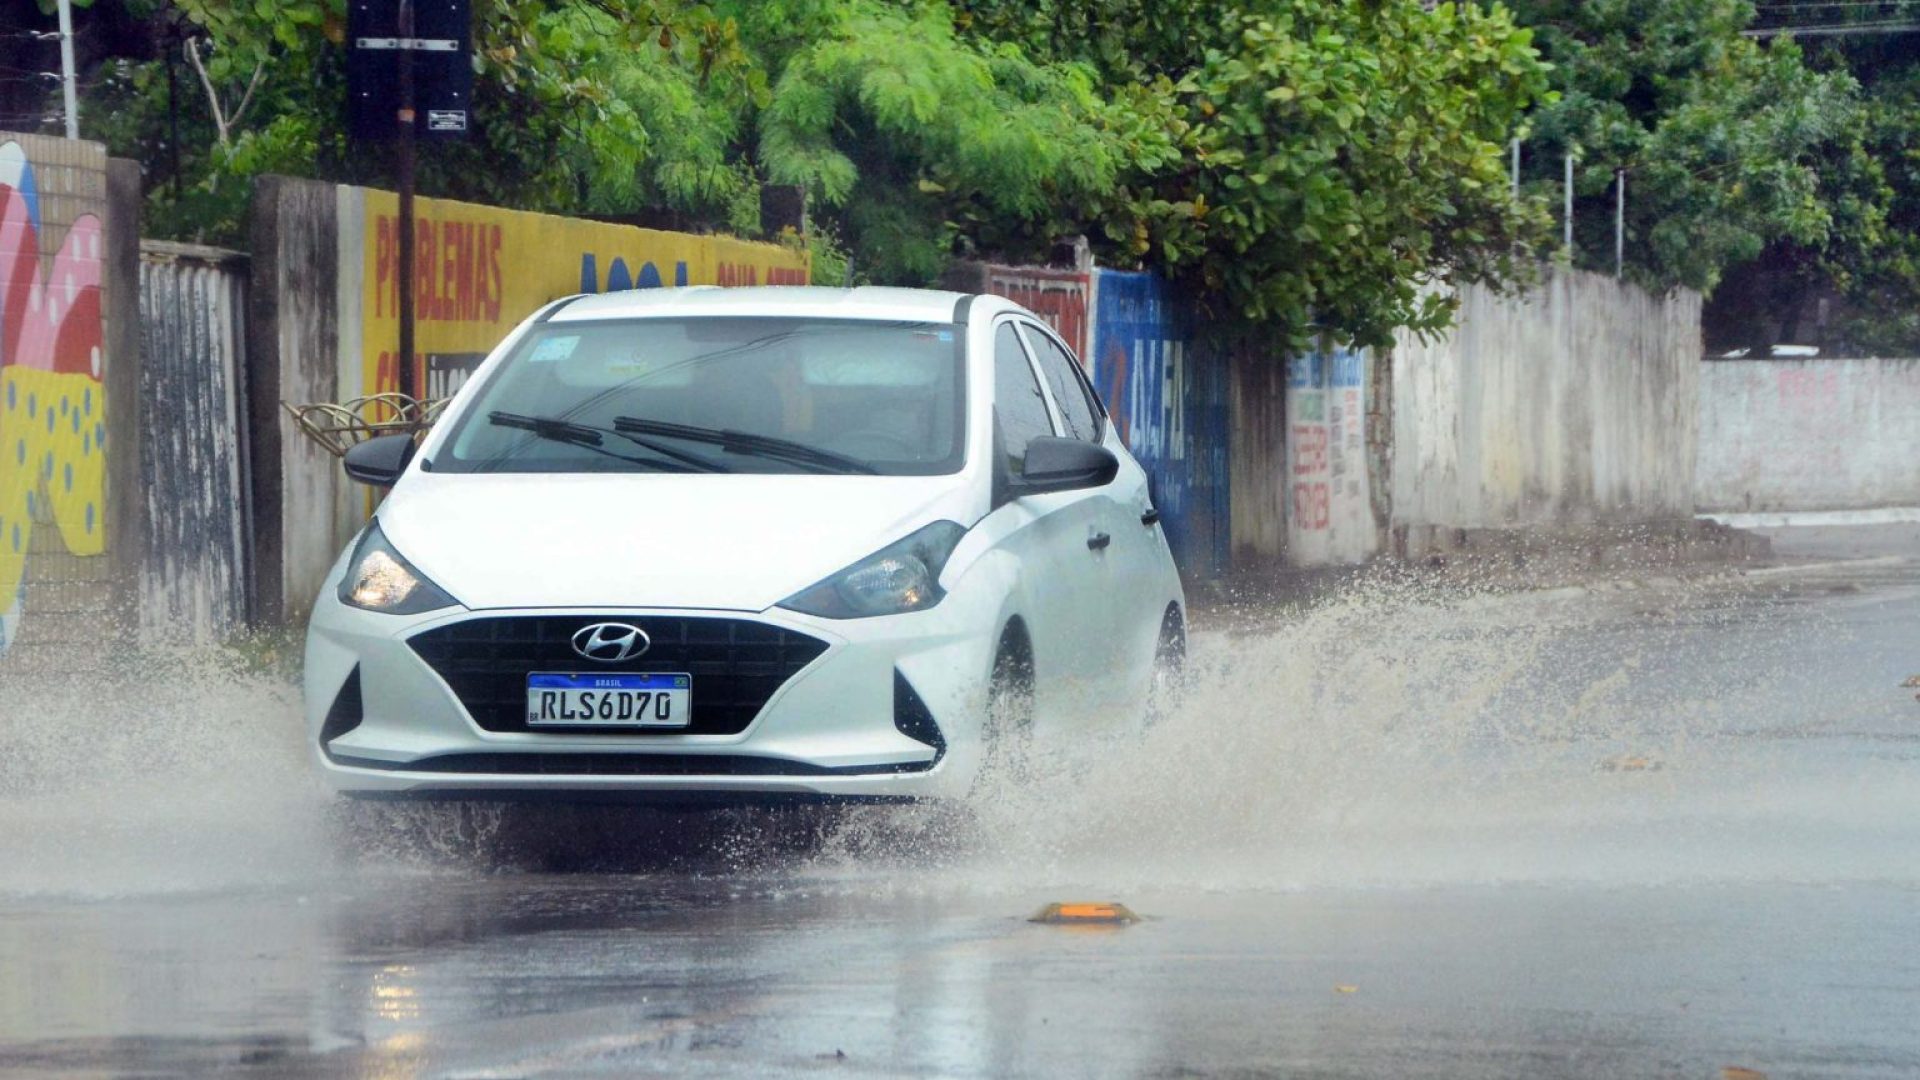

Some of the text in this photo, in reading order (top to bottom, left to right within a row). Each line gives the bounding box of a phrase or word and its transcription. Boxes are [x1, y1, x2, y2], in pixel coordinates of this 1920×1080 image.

[375, 214, 503, 324] PRBLEMAS
[595, 679, 622, 687] BRASIL
[541, 691, 671, 721] RLS6D70
